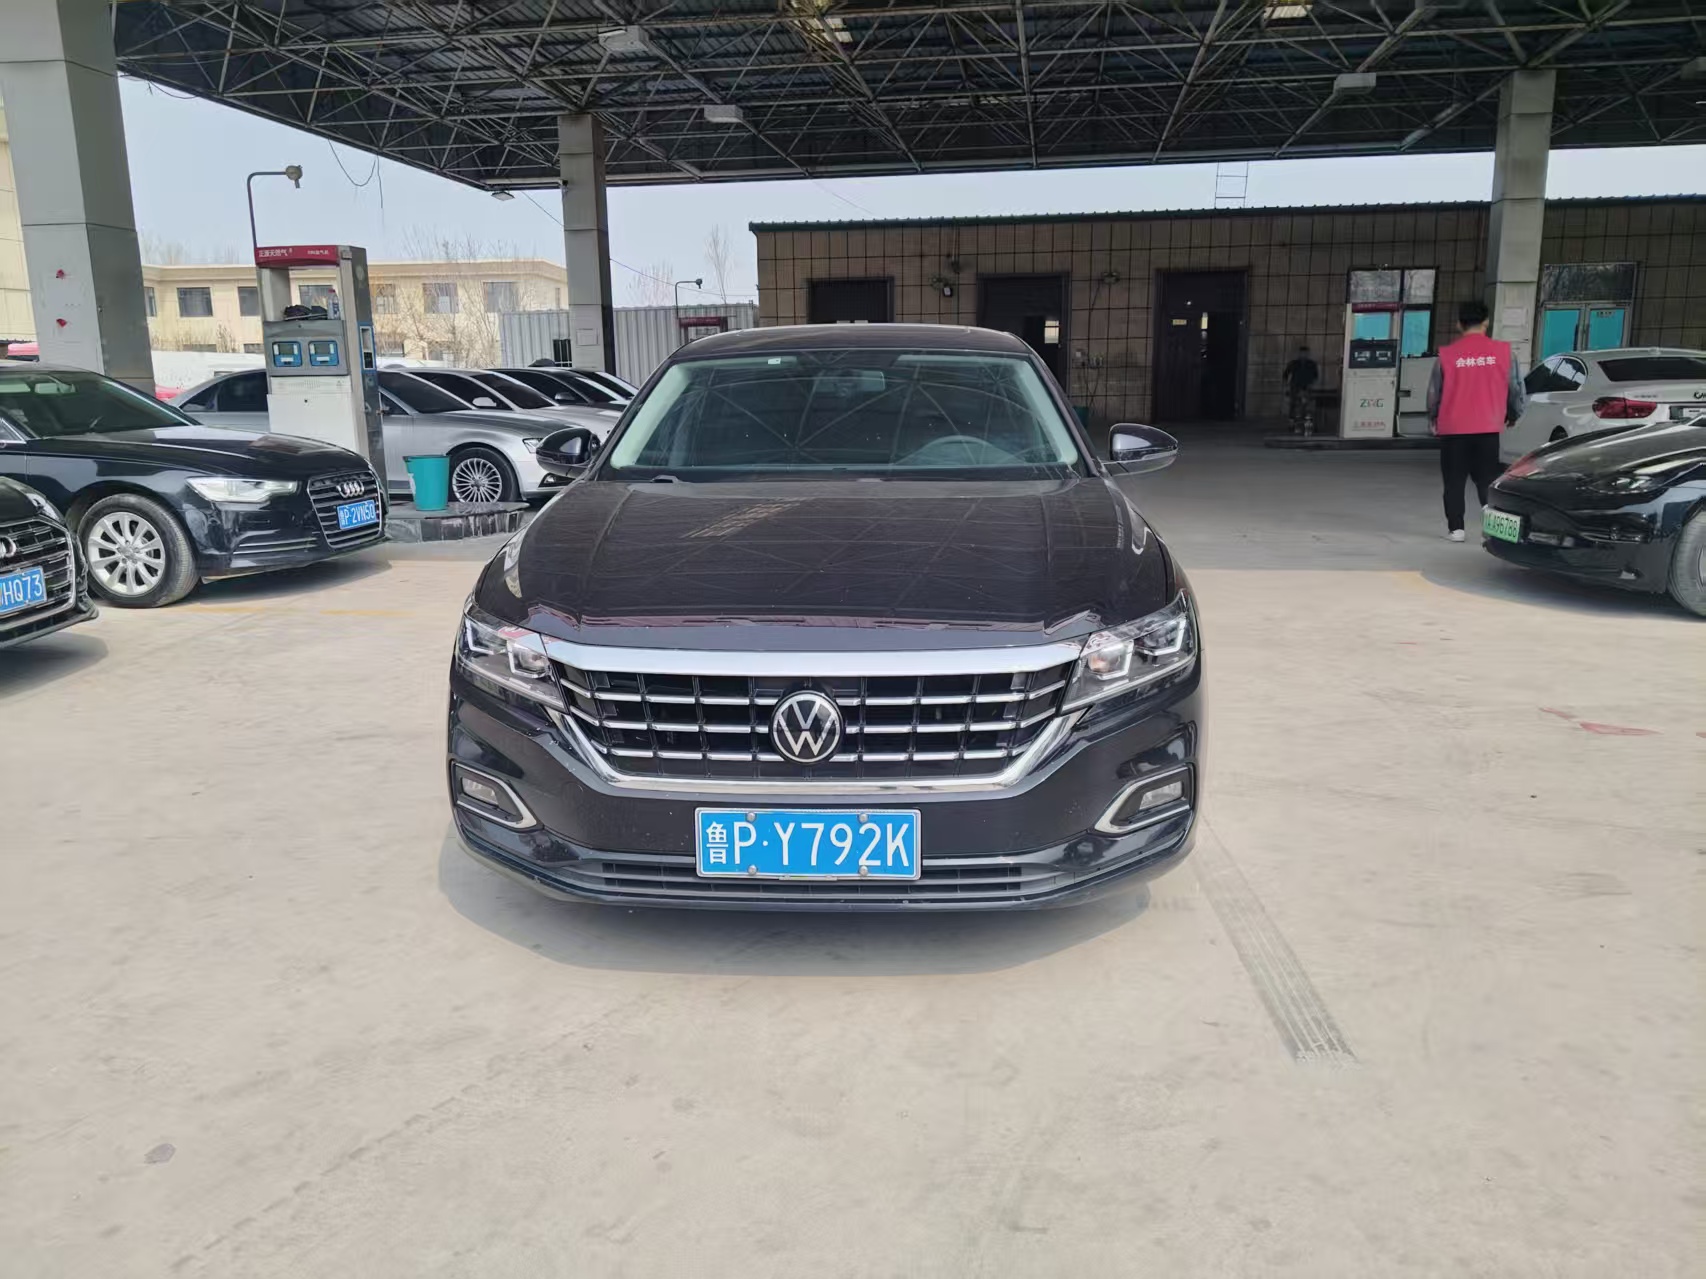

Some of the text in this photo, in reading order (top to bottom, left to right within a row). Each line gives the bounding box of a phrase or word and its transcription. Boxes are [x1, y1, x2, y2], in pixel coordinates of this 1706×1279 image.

[1455, 355, 1496, 368] 会林名车
[706, 821, 910, 867] 鲁P·Y792K
